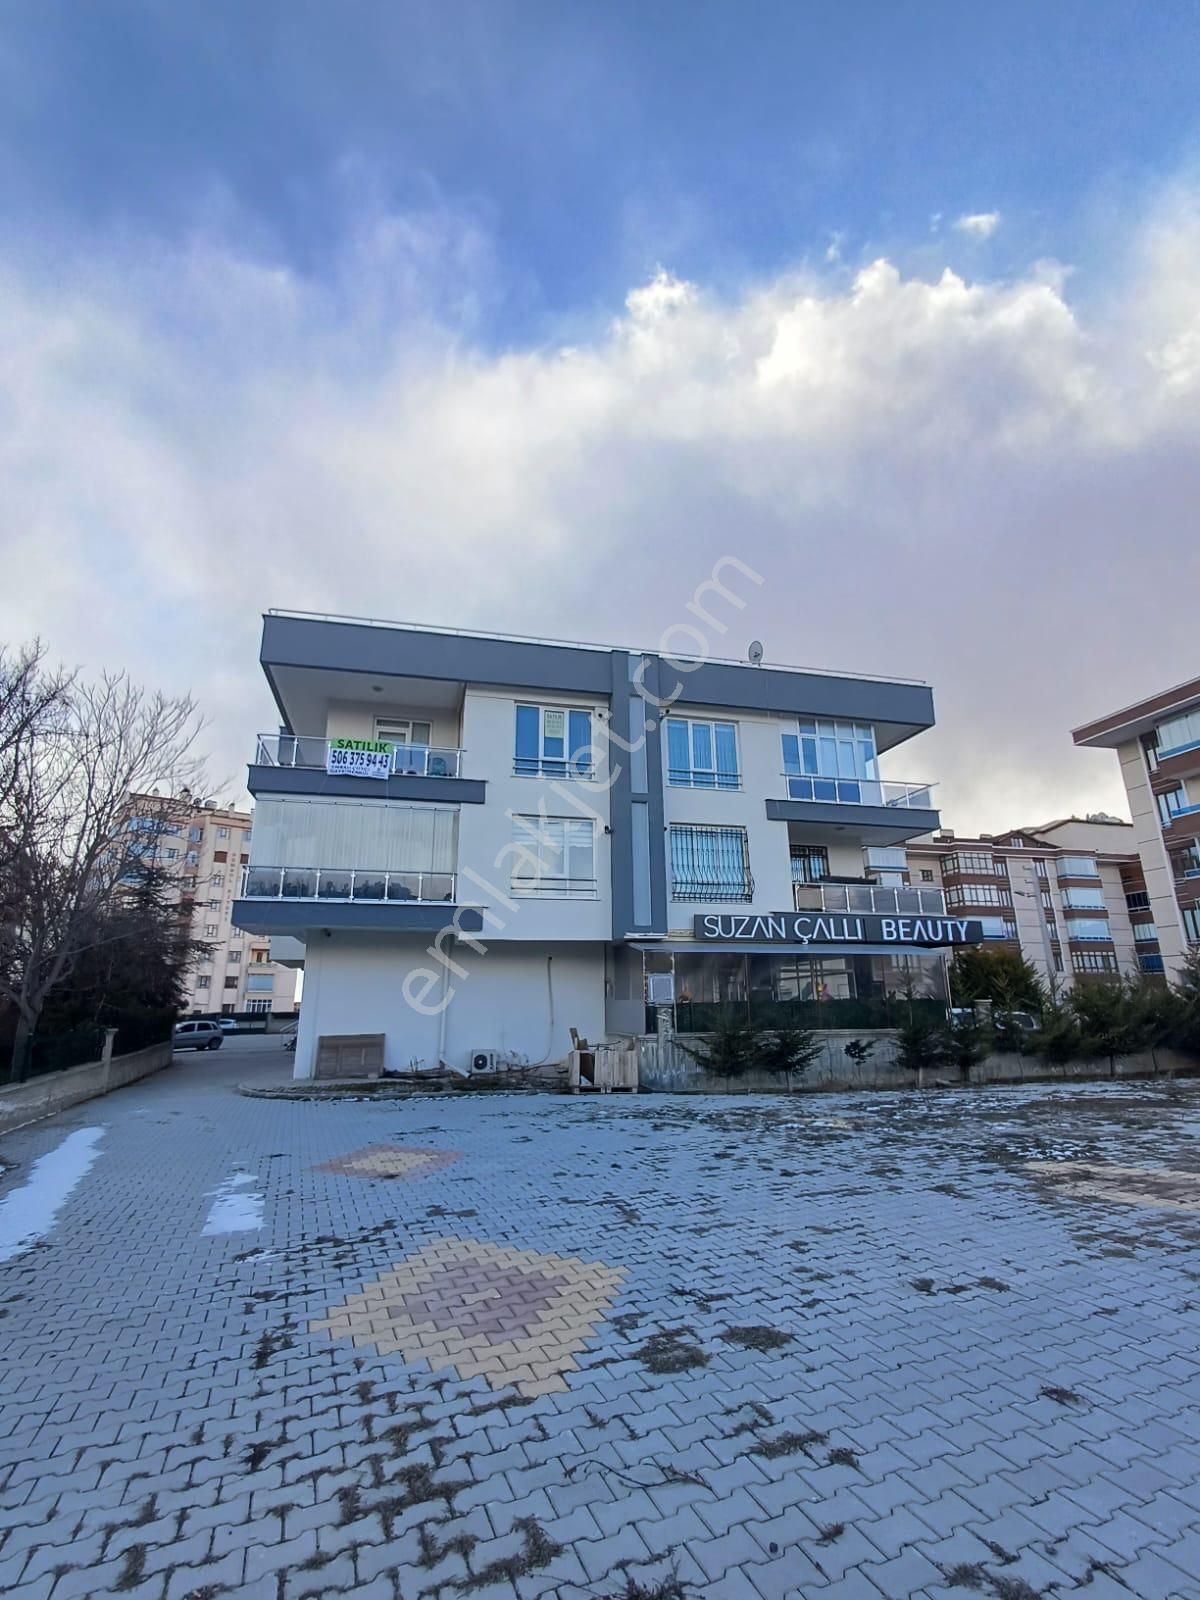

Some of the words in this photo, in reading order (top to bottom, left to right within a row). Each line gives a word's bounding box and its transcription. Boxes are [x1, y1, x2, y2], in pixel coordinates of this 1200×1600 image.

[337, 739, 387, 753] SATILIK
[332, 750, 348, 764] 506
[350, 751, 365, 765] 375
[366, 753, 377, 767] 94
[378, 754, 389, 768] 43
[703, 915, 786, 939] SUZAN
[793, 917, 863, 945] ÇALLI
[881, 919, 968, 942] BEAUTY
